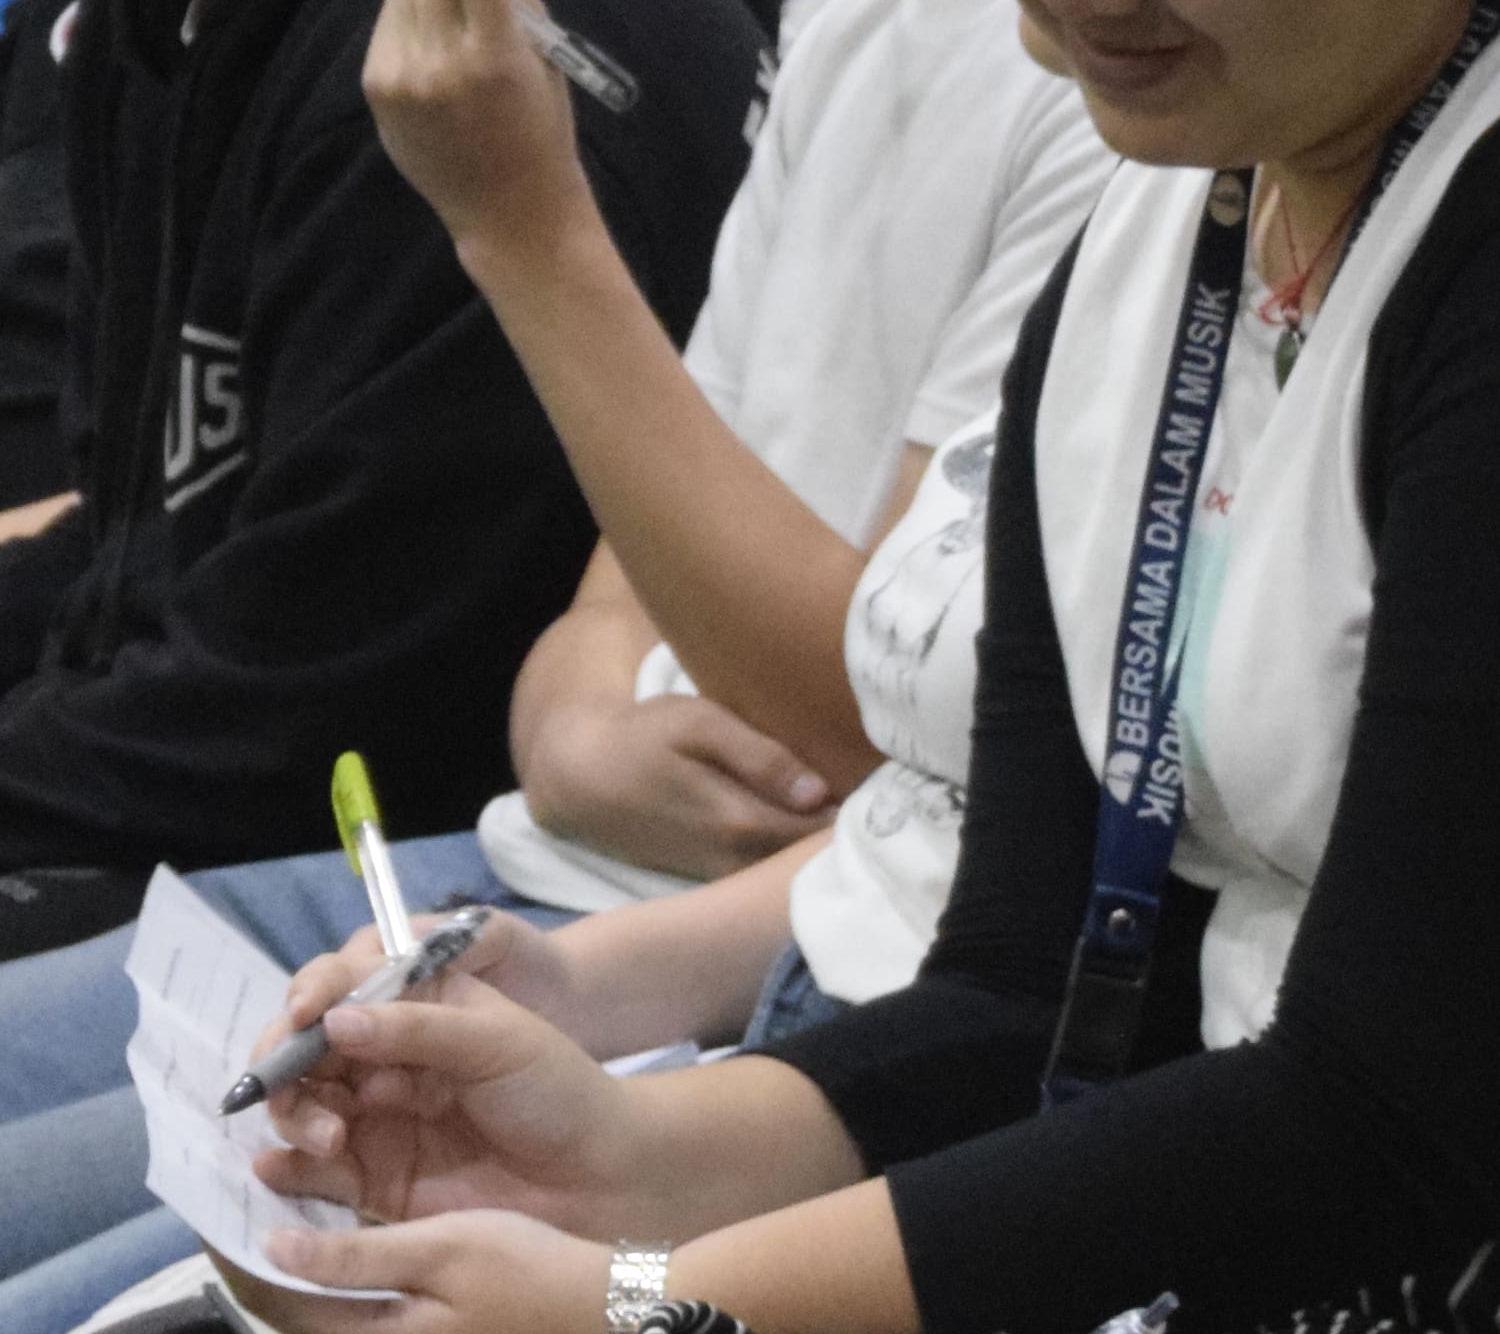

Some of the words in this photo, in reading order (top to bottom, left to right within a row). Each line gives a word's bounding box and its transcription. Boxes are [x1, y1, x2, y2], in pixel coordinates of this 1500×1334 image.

[1174, 282, 1232, 405] MUSIK
[1145, 412, 1205, 552] DALAM
[1115, 560, 1175, 748] BERSAMA
